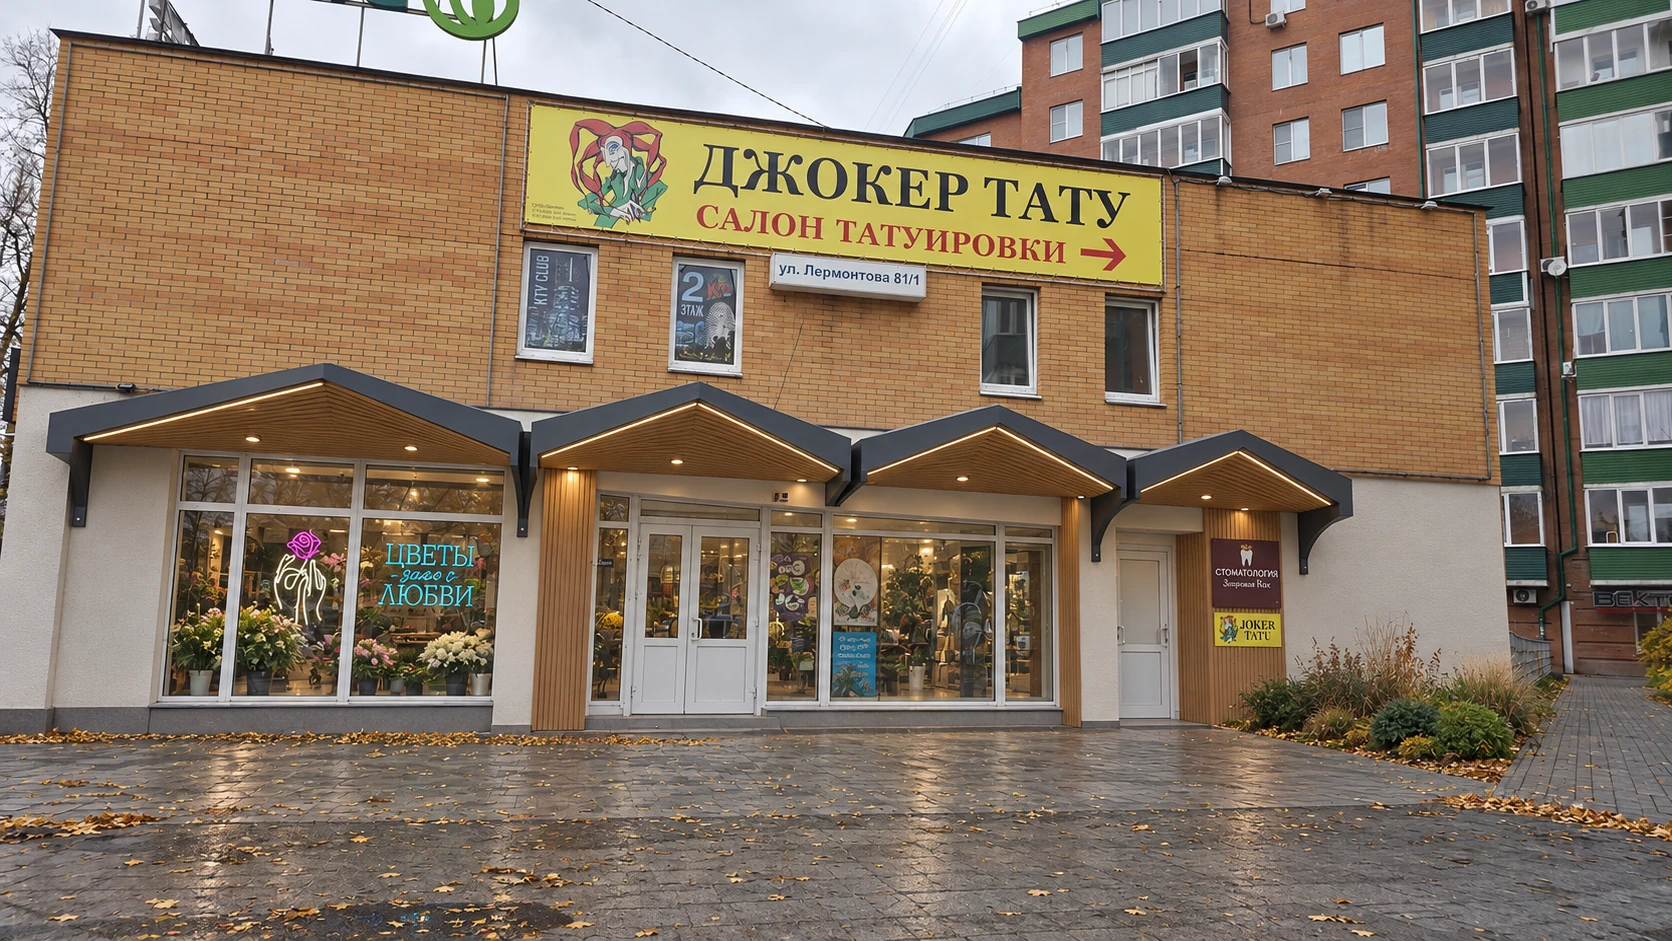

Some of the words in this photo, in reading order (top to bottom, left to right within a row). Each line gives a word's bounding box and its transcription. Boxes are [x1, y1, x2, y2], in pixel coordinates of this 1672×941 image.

[693, 143, 969, 212] ДЖОКЕР
[984, 176, 1131, 229] ТАТУ
[696, 204, 824, 240] САЛОН
[835, 219, 1067, 264] ТАТУИРОВКИ
[535, 255, 549, 282] CLUB
[779, 264, 800, 277] ул.
[803, 264, 890, 283] Лермонтова
[893, 272, 920, 286] 81/1
[533, 284, 548, 306] KTY
[681, 271, 704, 303] 2
[385, 542, 475, 568] ЦВЕТЫ
[1215, 568, 1279, 578] СТОМАТОЛОГИЯ
[378, 584, 473, 608] ЛЮБВИ
[1592, 590, 1672, 607] ВЕКТ
[1240, 619, 1276, 630] JOKER
[1244, 630, 1271, 641] TATU
